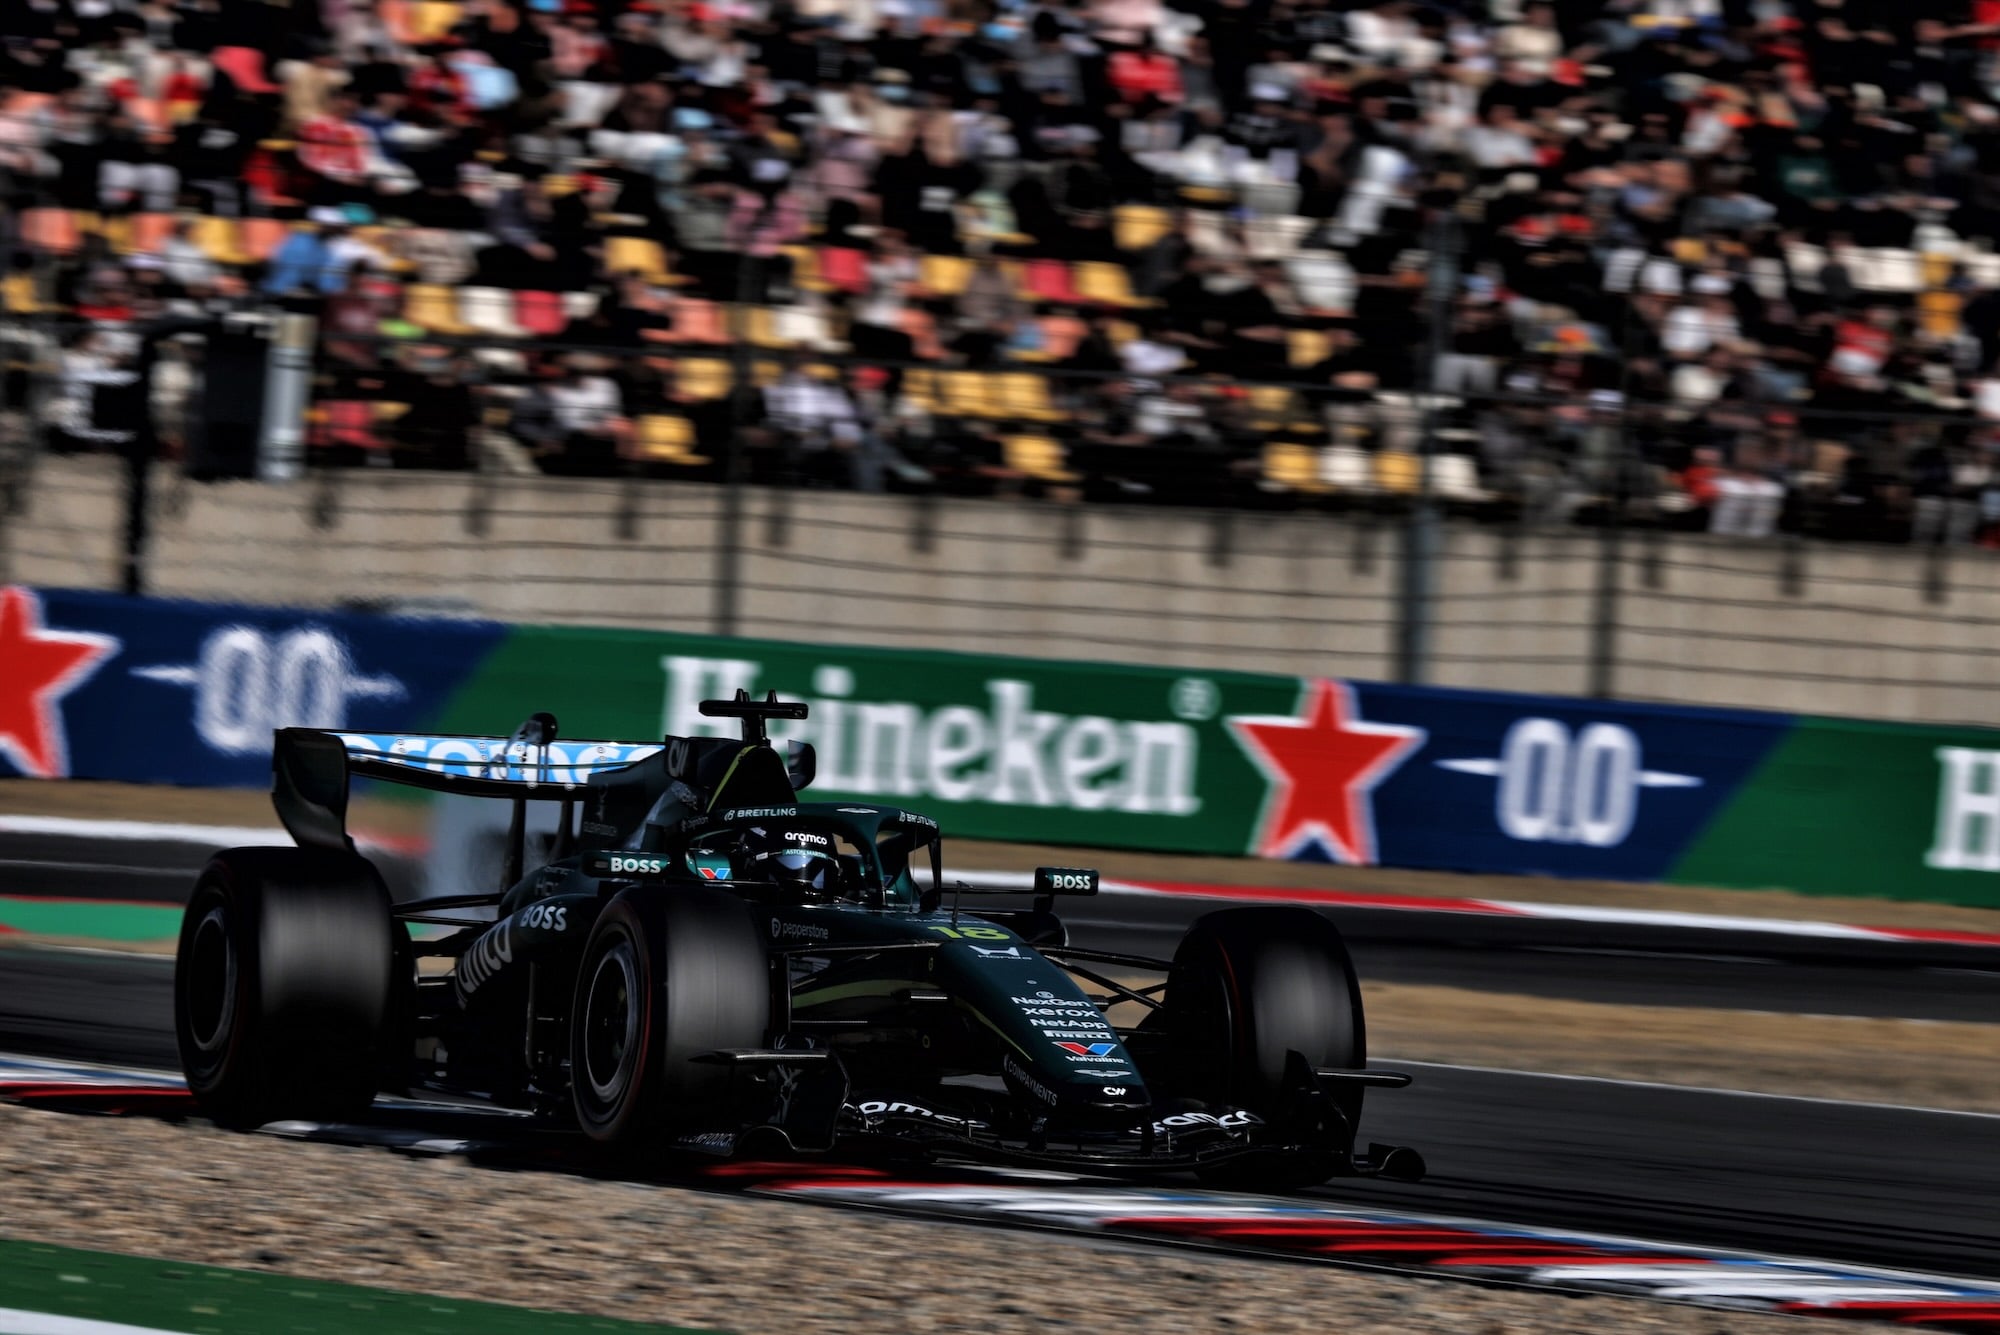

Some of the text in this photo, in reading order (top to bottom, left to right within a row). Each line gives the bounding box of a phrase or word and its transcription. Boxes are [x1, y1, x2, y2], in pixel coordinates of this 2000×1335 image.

[737, 807, 797, 818] BREITLING
[784, 831, 828, 846] aramco
[611, 857, 662, 874] BOSS
[1053, 873, 1092, 890] BOSS
[520, 904, 568, 932] BOSS
[783, 921, 830, 940] pepperstone
[927, 926, 1011, 940] 18
[1011, 996, 1091, 1008] NexGen
[1022, 1007, 1101, 1019] xerox
[1029, 1018, 1108, 1030] NetApp
